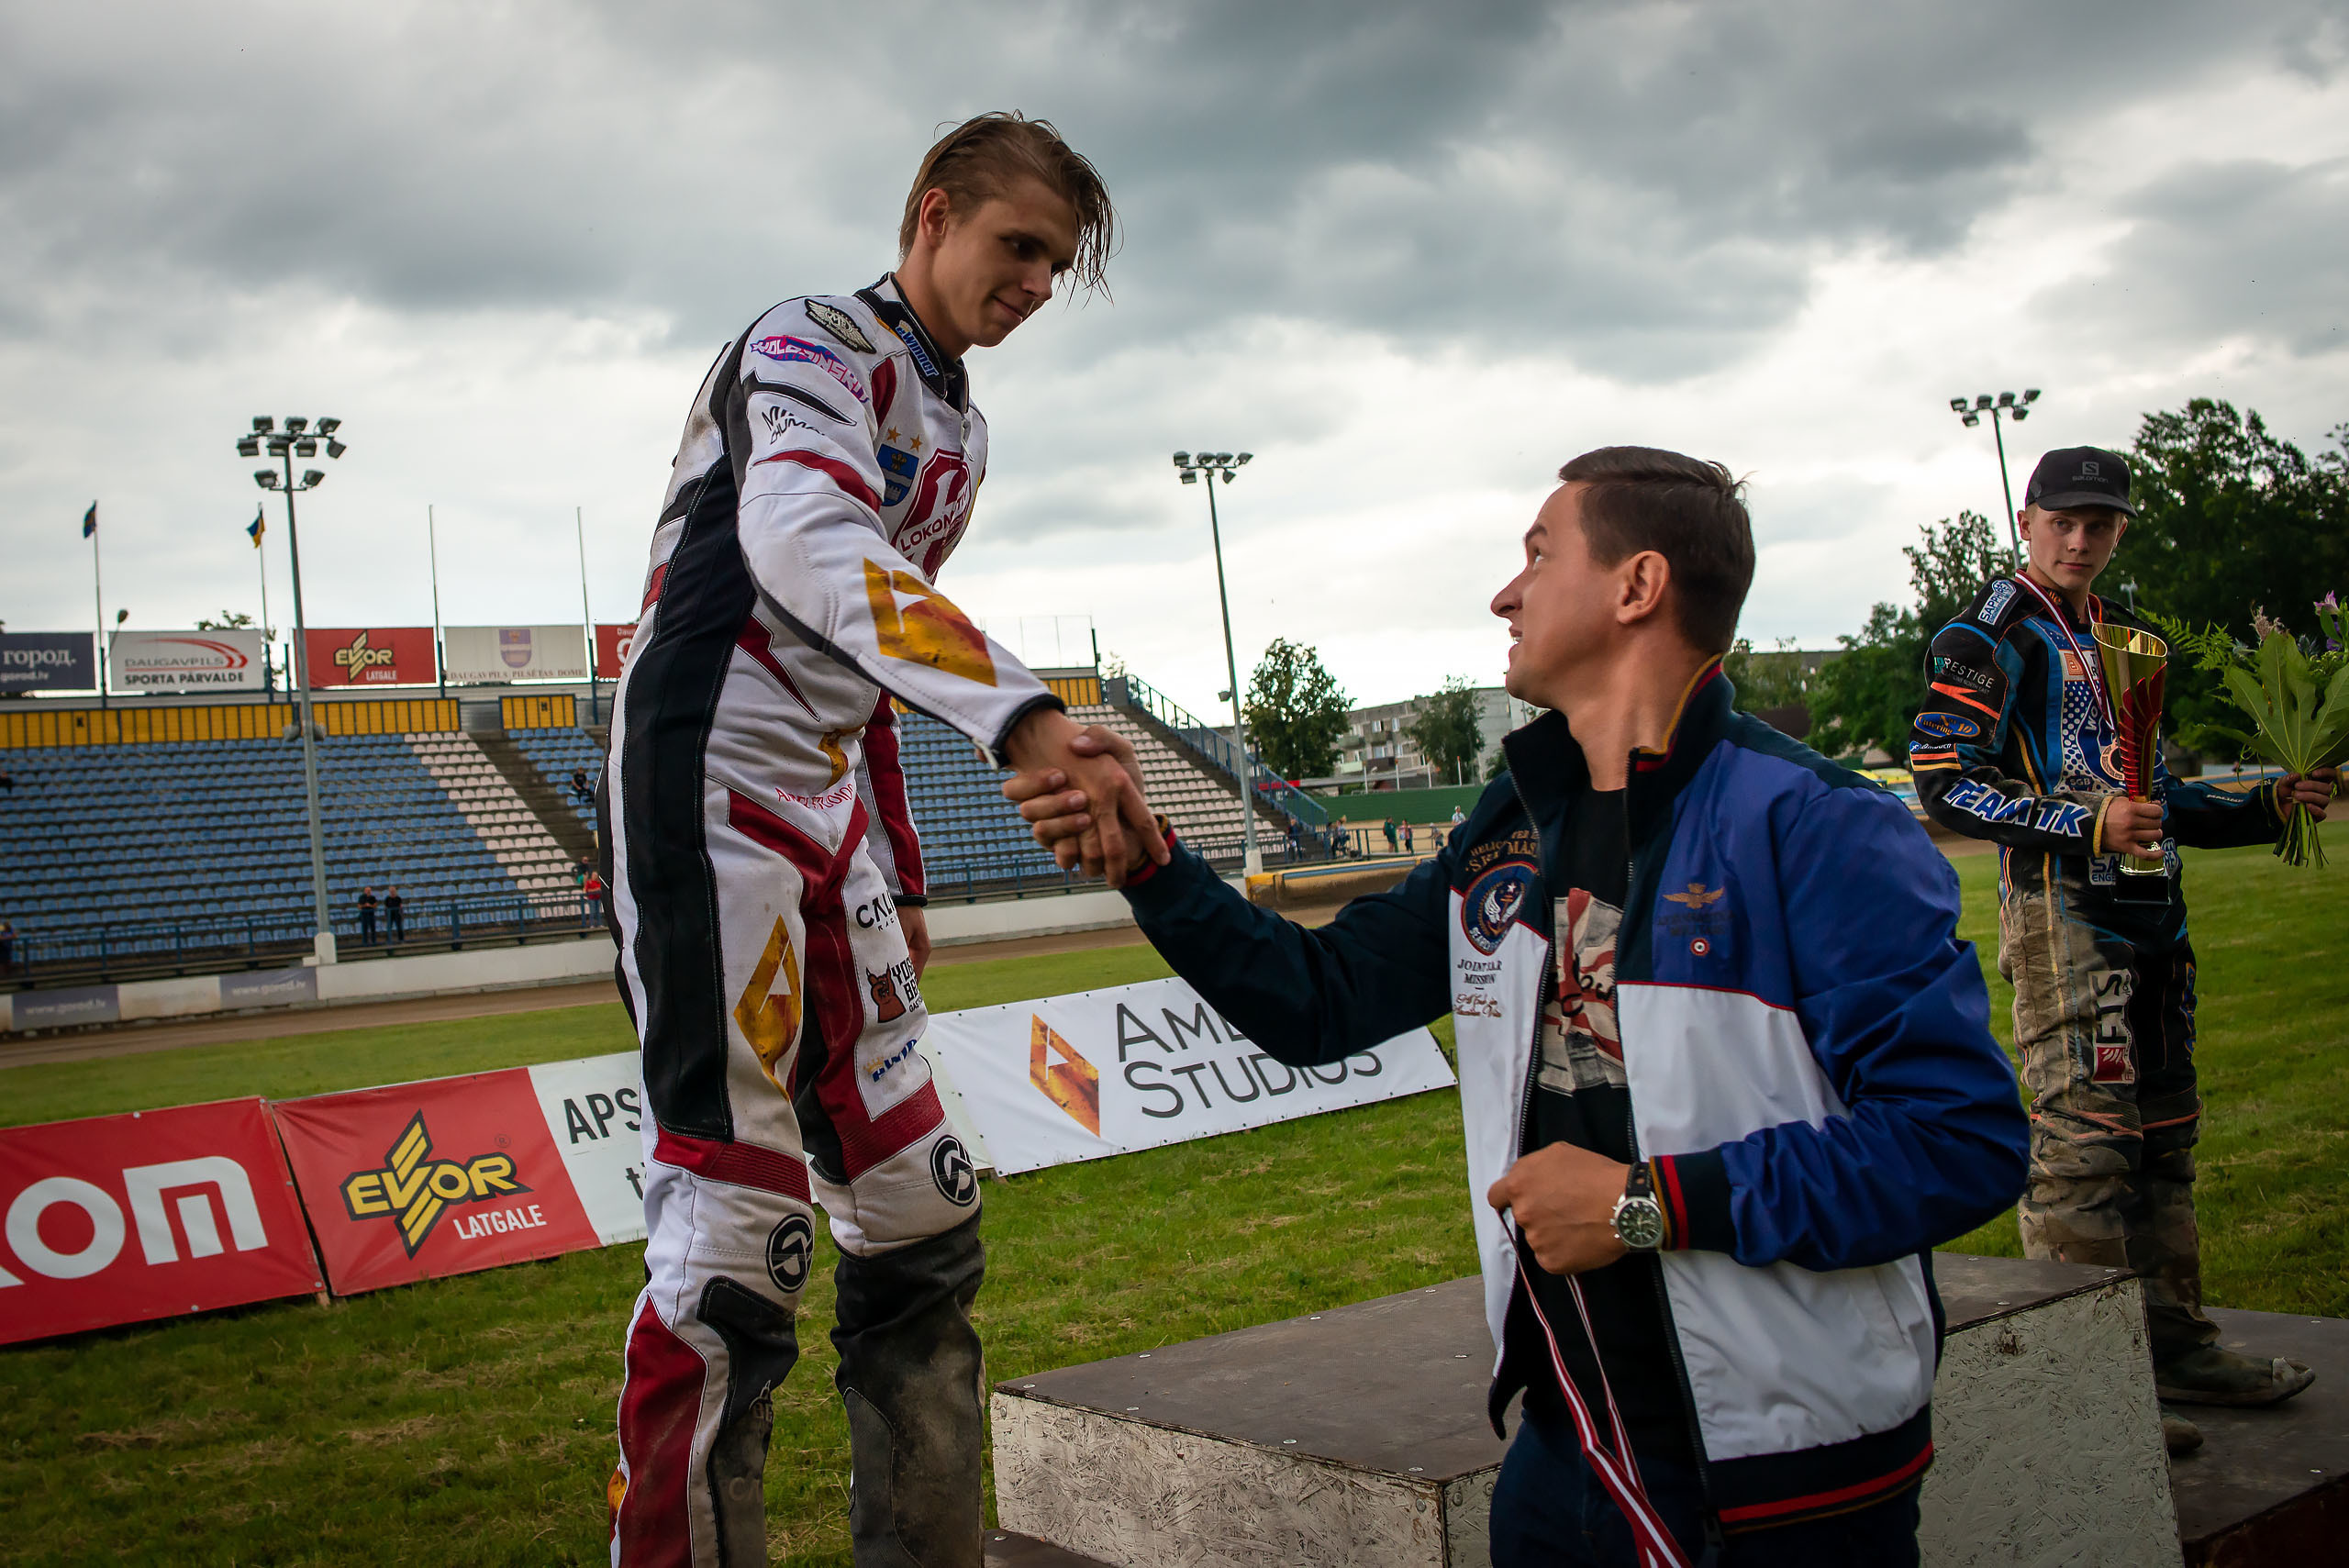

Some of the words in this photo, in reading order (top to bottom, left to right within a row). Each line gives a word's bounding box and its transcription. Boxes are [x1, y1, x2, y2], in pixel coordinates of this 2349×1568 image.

[2072, 475, 2109, 484] salomon
[3, 649, 77, 668] город.
[125, 657, 224, 667] DAUGAVPILS
[125, 673, 175, 684] SPORTA
[179, 671, 243, 683] PĀRVALDE
[366, 670, 396, 682] LATGALE
[451, 670, 507, 680] DAUGAVPILS
[558, 667, 583, 677] DOME
[1919, 716, 1954, 736] Catering
[2070, 778, 2091, 786] SGB
[1943, 778, 2035, 827] TEAM
[2034, 796, 2093, 838] TK
[453, 1204, 548, 1240] LATGALE
